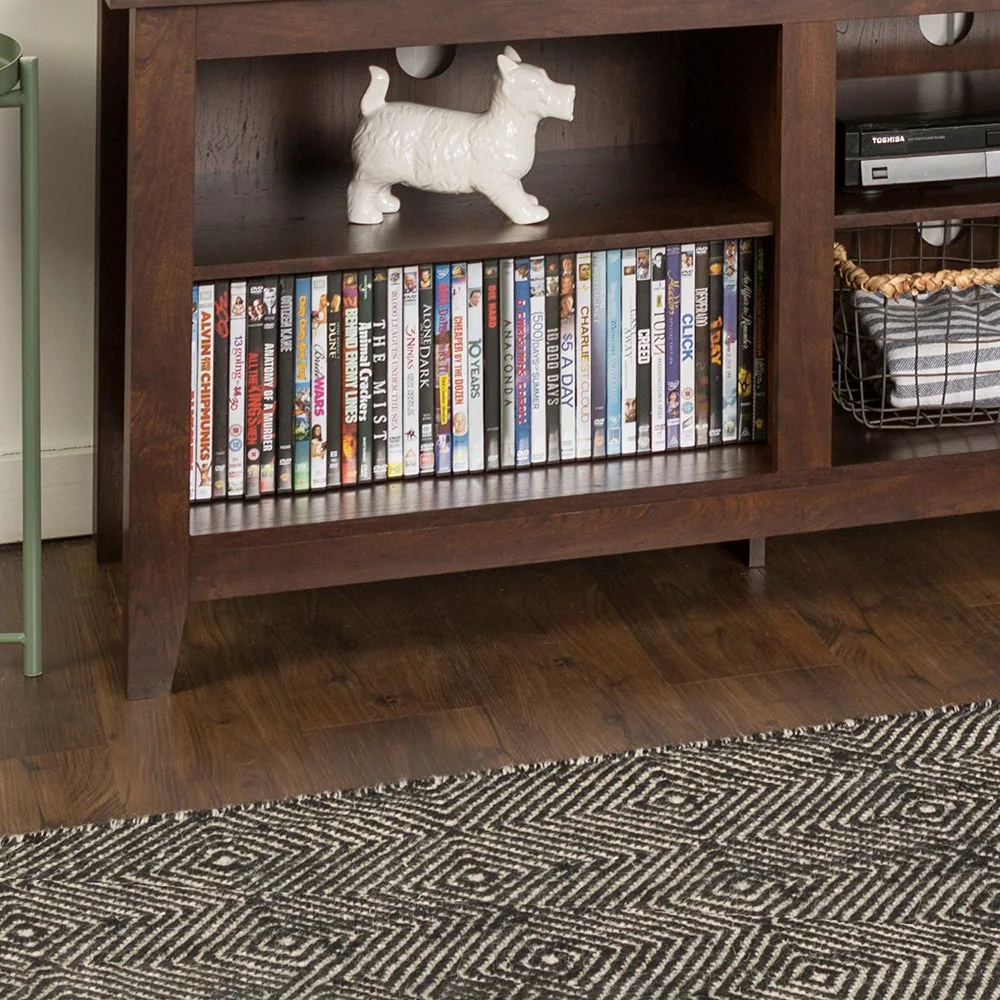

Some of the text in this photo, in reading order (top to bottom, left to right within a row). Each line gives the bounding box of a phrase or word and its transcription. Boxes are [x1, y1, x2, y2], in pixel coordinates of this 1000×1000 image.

[871, 135, 905, 144] TOSHIBA
[214, 290, 230, 339] 300
[487, 284, 498, 329] DIE HARD
[667, 270, 681, 316] Aladdin
[695, 287, 709, 328] DESPERADO
[233, 335, 244, 347] 13
[280, 294, 294, 353] CITIZEN KANE
[328, 321, 338, 360] DUNE
[390, 319, 400, 360] LEAGUES
[422, 303, 433, 346] ALONE
[516, 311, 528, 378] CHRISTMAS
[531, 311, 544, 343] (500)
[581, 305, 590, 361] CHARLIE
[682, 313, 694, 362] CLICK
[231, 347, 245, 380] going
[263, 342, 275, 388] ANATOMY
[344, 307, 359, 425] BEHIND ENEMY LINES
[405, 324, 417, 371] 3 NINJAS
[419, 345, 432, 390] DARK
[453, 315, 465, 406] CHEAPER BY THE DOZEN
[468, 338, 482, 400] 10 YEARS
[503, 319, 514, 409] ANACONDA
[532, 342, 540, 366] DAYS
[546, 327, 560, 407] 10,000 DAYS
[638, 328, 650, 365] CREED
[200, 310, 212, 461] ALVIN CHIPMUNKS
[312, 343, 326, 418] Bride WARS
[358, 321, 373, 422] Animal Crackers
[372, 318, 388, 442] THE MIST
[390, 360, 400, 392] UNDER
[531, 372, 540, 411] SUMMER
[561, 332, 574, 409] $5 A DAY
[263, 389, 274, 402] OF
[263, 402, 273, 411] A
[390, 393, 400, 410] THE
[262, 412, 274, 453] MURDER
[390, 412, 400, 431] SEA
